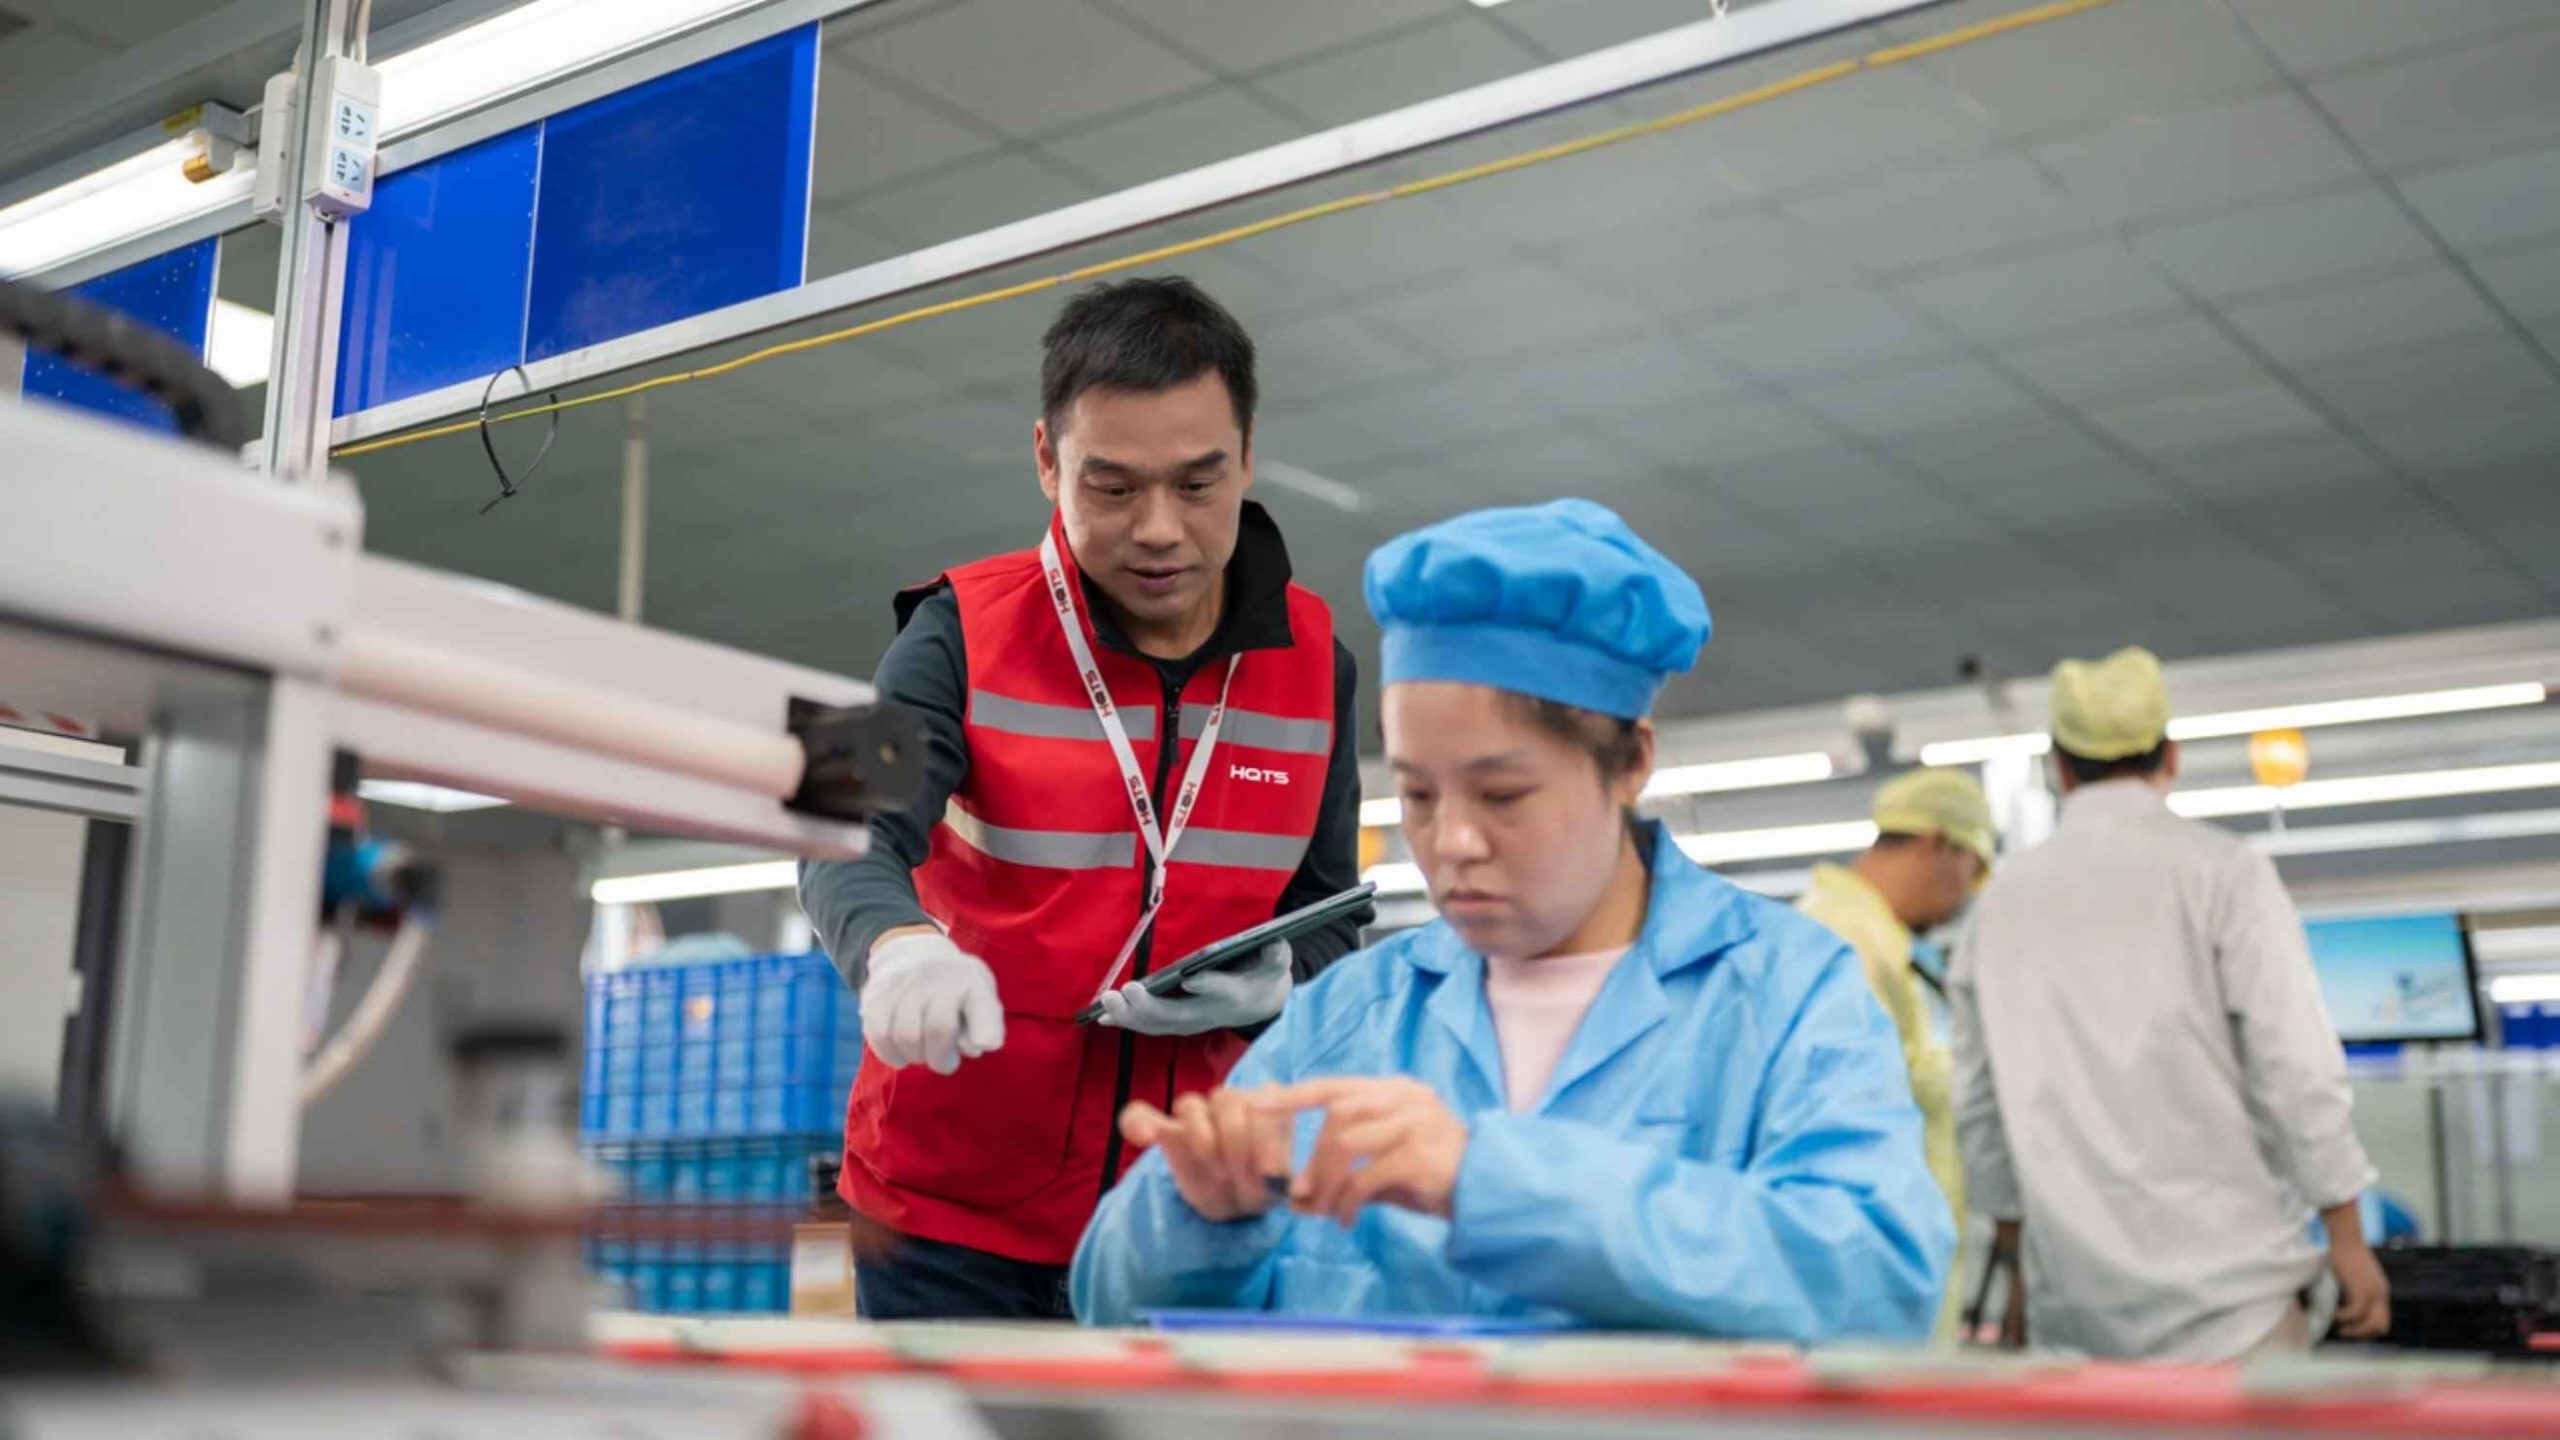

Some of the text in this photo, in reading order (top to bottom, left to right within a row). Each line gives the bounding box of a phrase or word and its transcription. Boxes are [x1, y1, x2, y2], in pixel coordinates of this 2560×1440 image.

[1049, 568, 1071, 614] HQTS
[1085, 670, 1112, 717] HQTS
[1230, 764, 1290, 785] HQTS
[1129, 775, 1152, 825] HQTS
[1174, 782, 1197, 829] HQTS
